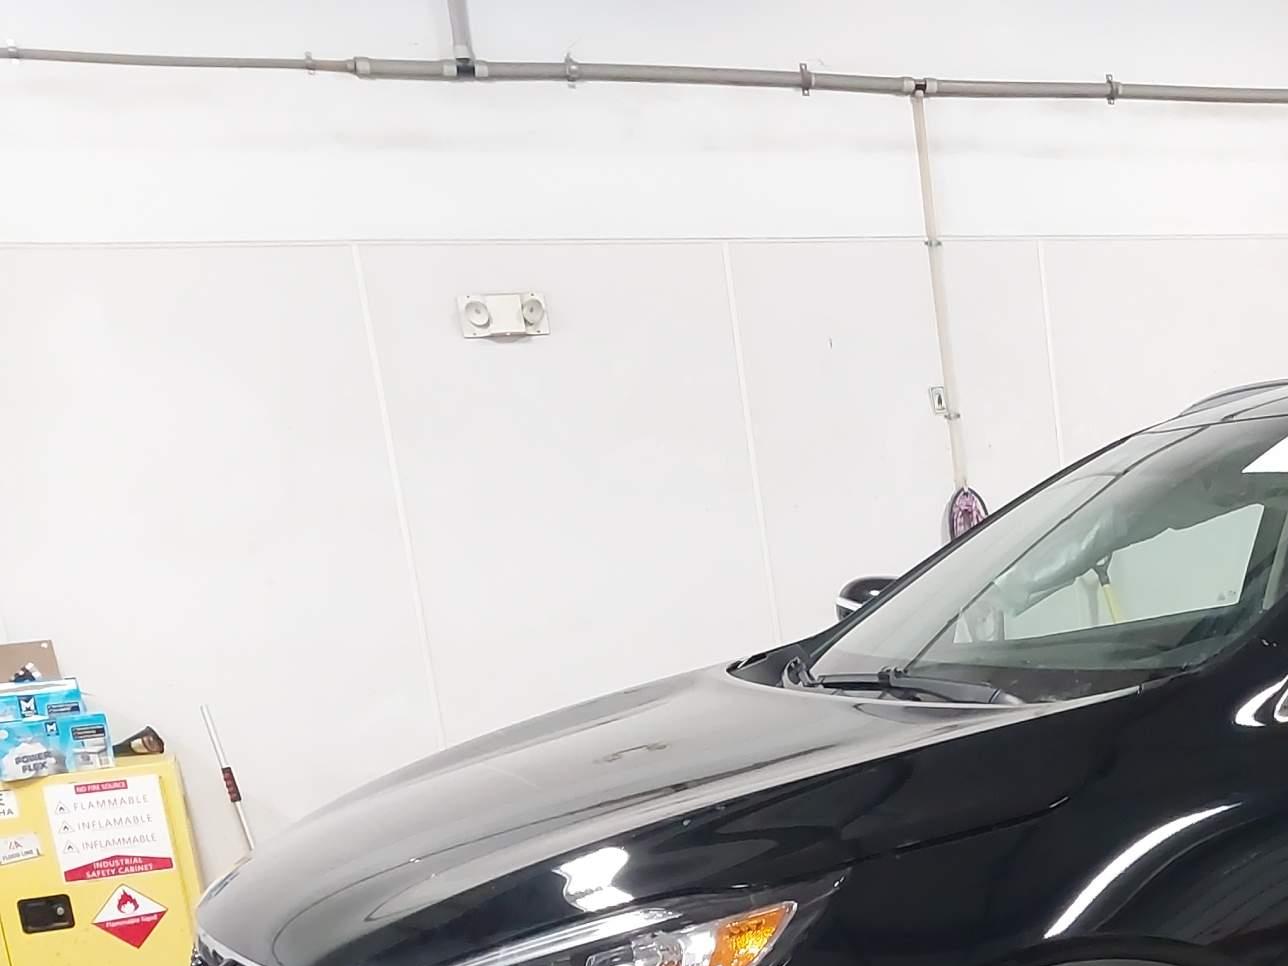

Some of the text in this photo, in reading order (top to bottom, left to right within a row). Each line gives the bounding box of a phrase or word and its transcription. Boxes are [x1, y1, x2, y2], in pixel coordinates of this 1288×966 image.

[15, 751, 51, 764] POWER
[22, 761, 48, 773] FLEX
[73, 794, 149, 811] FLAMMABLE
[78, 814, 153, 831] INFLAMABLE
[81, 833, 157, 850] INFLAMMABLE
[86, 863, 153, 878] SAFETY CABINET
[93, 857, 143, 869] INDUSTRIAL
